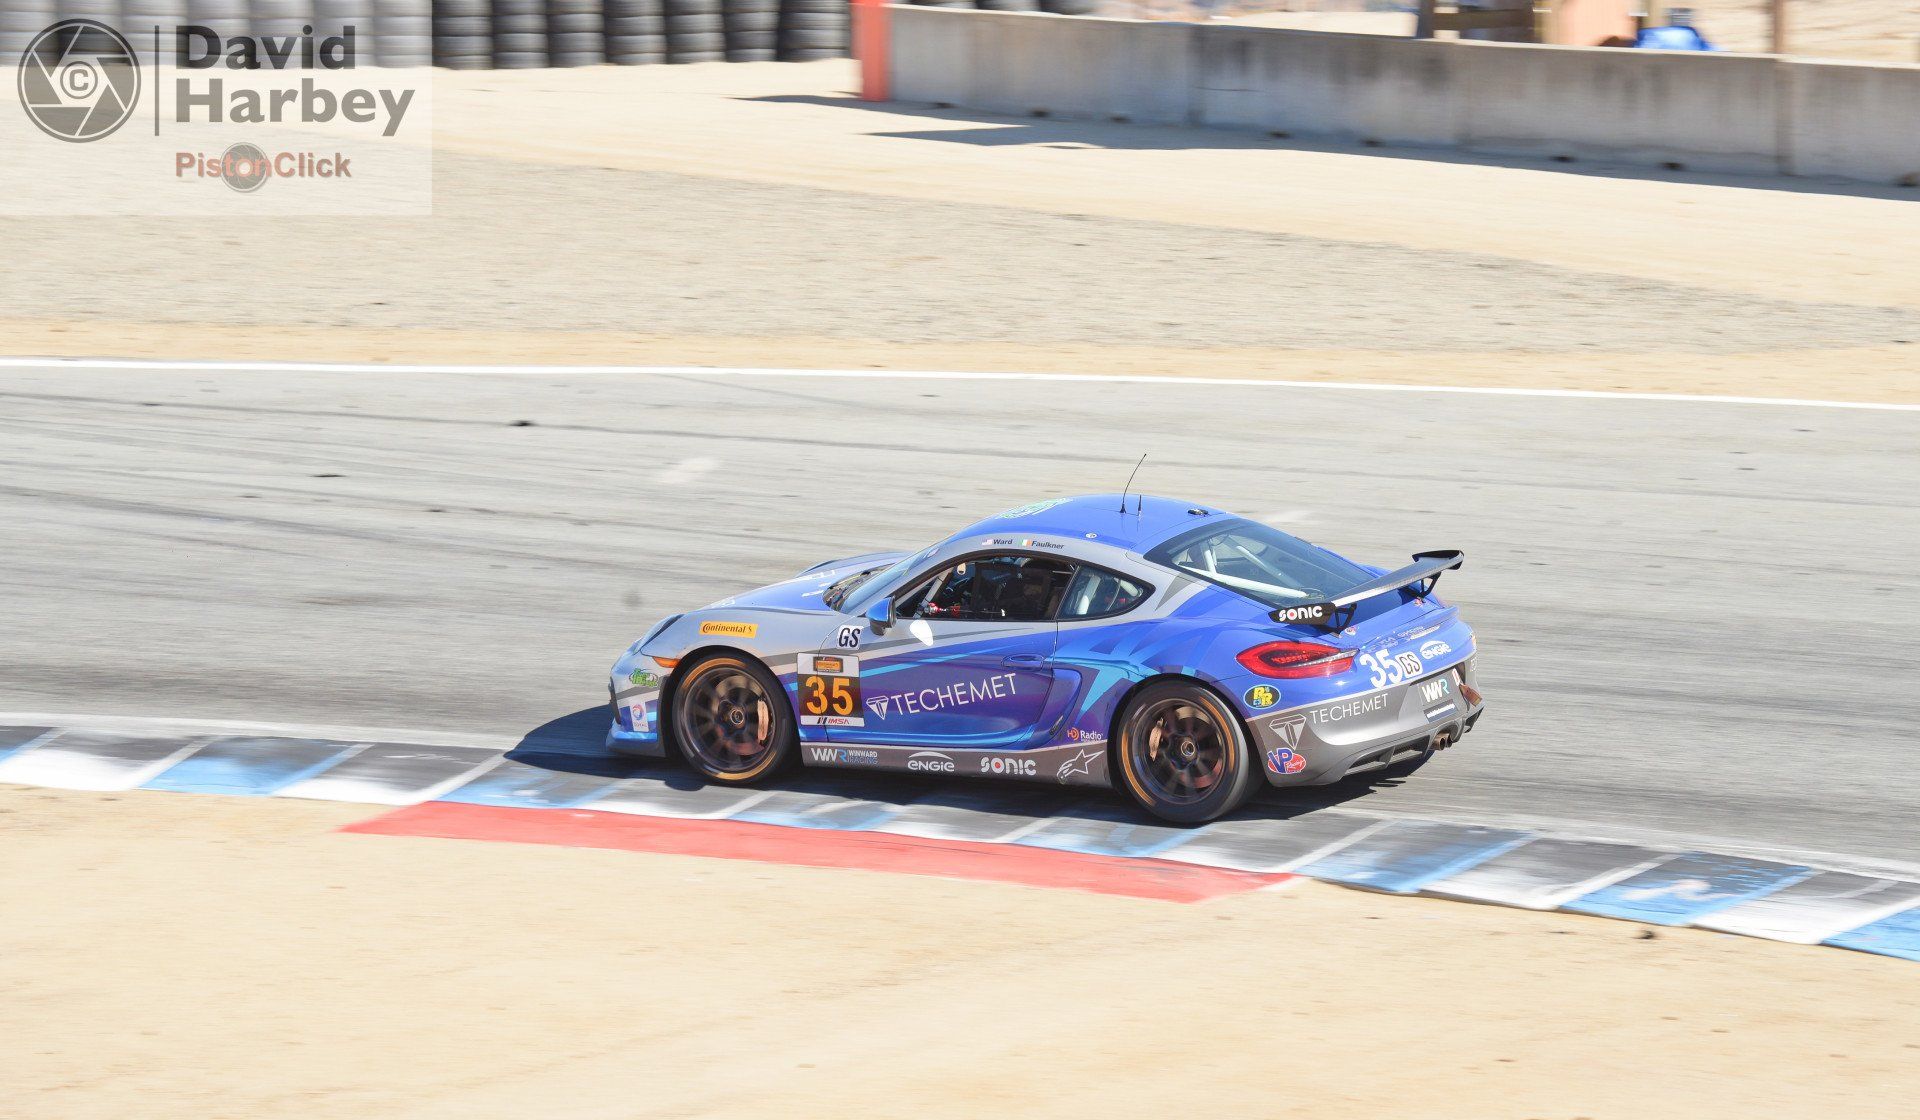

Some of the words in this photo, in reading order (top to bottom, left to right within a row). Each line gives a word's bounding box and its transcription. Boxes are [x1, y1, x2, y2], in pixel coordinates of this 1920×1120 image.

[1031, 540, 1065, 549] Faulkner
[1278, 605, 1323, 622] SONIC
[702, 623, 746, 633] Continental
[838, 627, 861, 648] GS
[1359, 648, 1403, 688] 35
[1399, 654, 1421, 675] GS
[805, 675, 854, 716] 35
[891, 672, 1017, 716] TECHEMET
[1421, 678, 1450, 703] WWR
[1309, 692, 1389, 724] TECHEMET
[1080, 730, 1102, 740] Radio
[848, 750, 878, 758] WINWARD
[1267, 748, 1293, 774] VP
[980, 756, 1037, 776] SONIC
